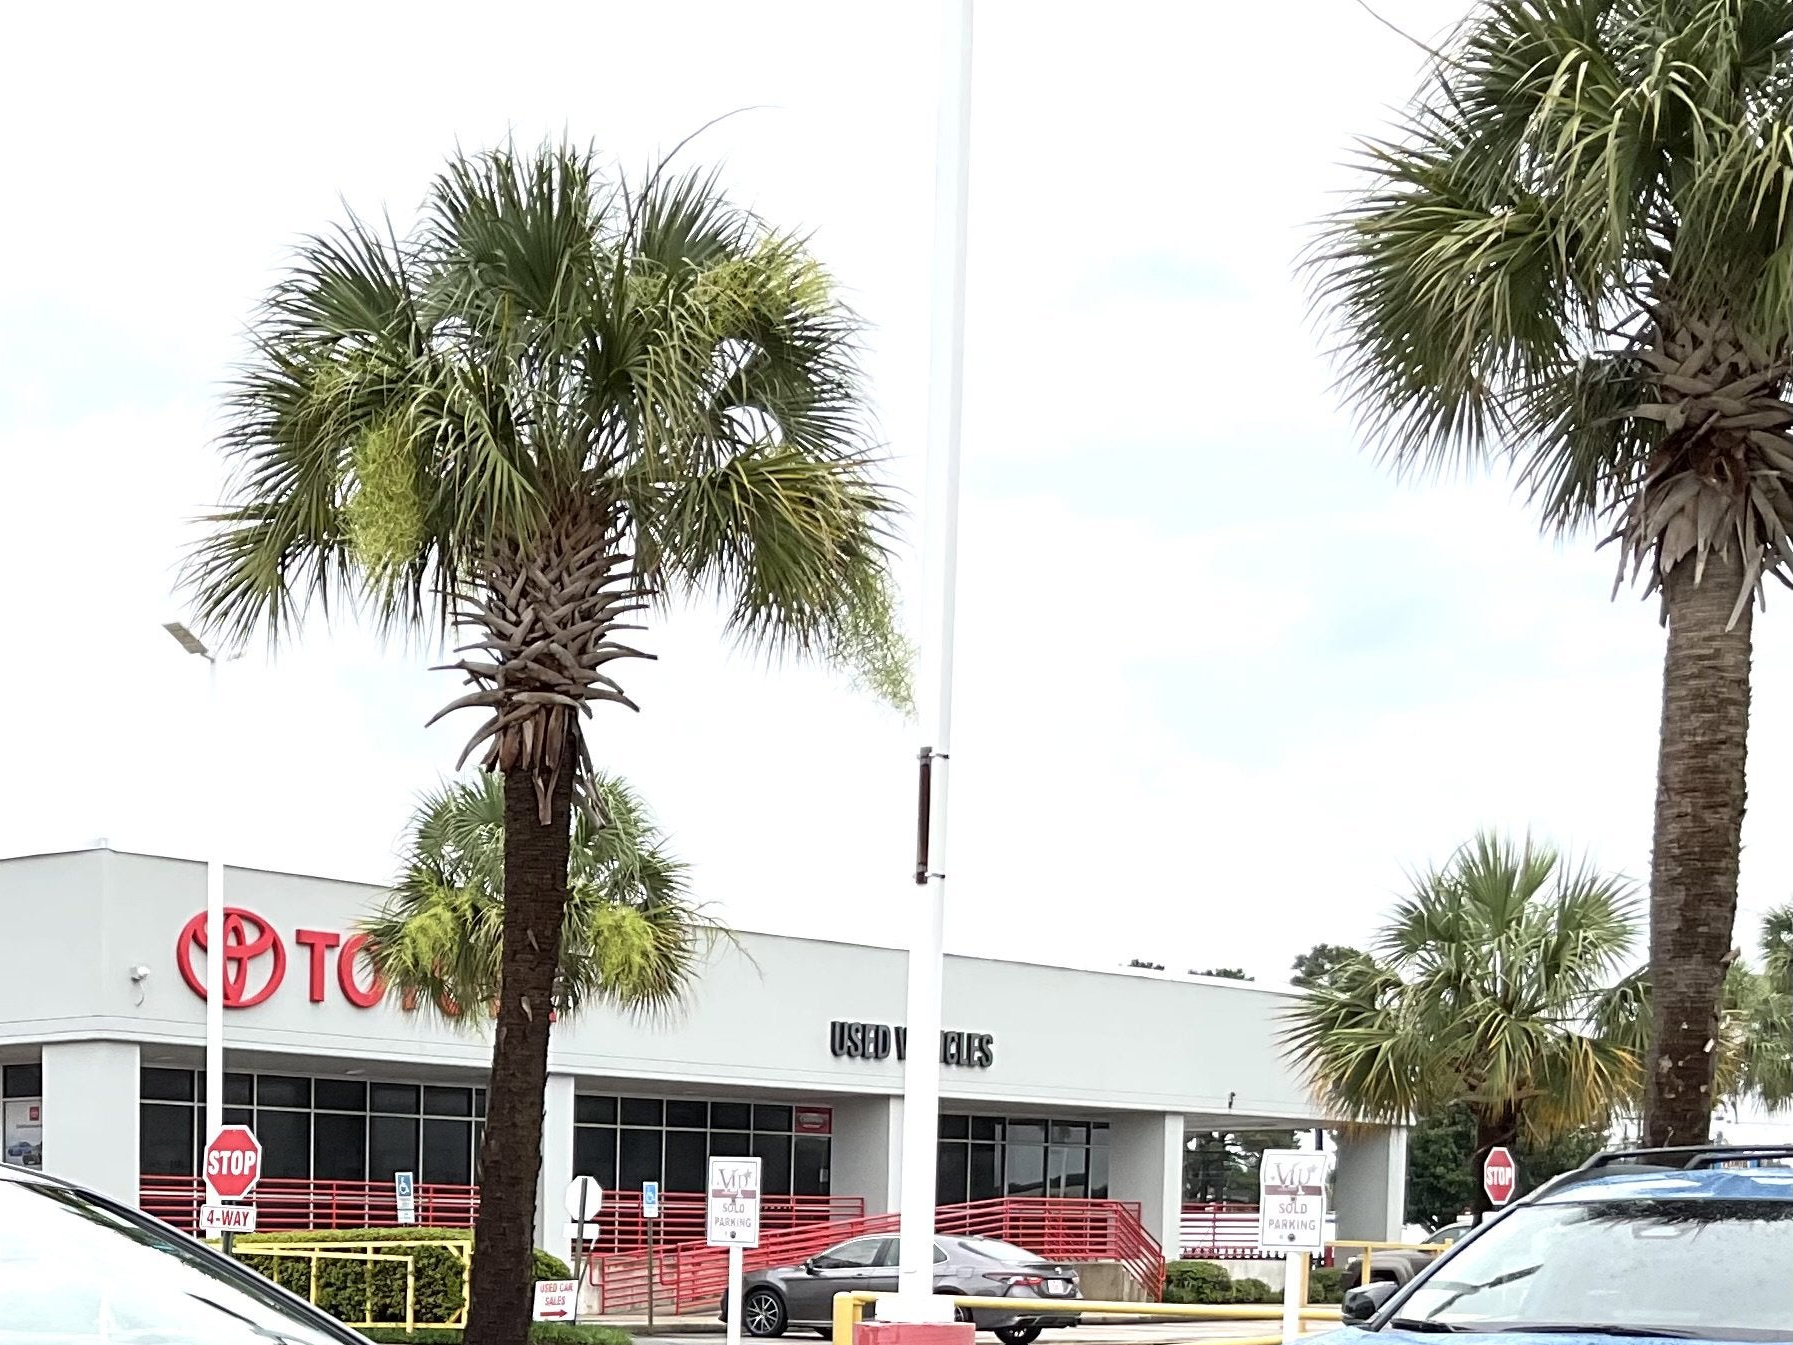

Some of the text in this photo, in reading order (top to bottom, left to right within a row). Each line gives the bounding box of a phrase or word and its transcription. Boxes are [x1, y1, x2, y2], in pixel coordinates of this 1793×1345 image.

[830, 1021, 892, 1060] USED
[207, 1149, 257, 1176] STOP
[1486, 1166, 1512, 1186] STOP
[722, 1202, 745, 1214] SOLD
[1278, 1202, 1308, 1214] SOLD
[207, 1209, 250, 1227] 4-WAY
[714, 1216, 752, 1228] PARKING
[1268, 1218, 1316, 1231] PARKING
[539, 1282, 558, 1293] USED
[544, 1295, 566, 1306] SALES
